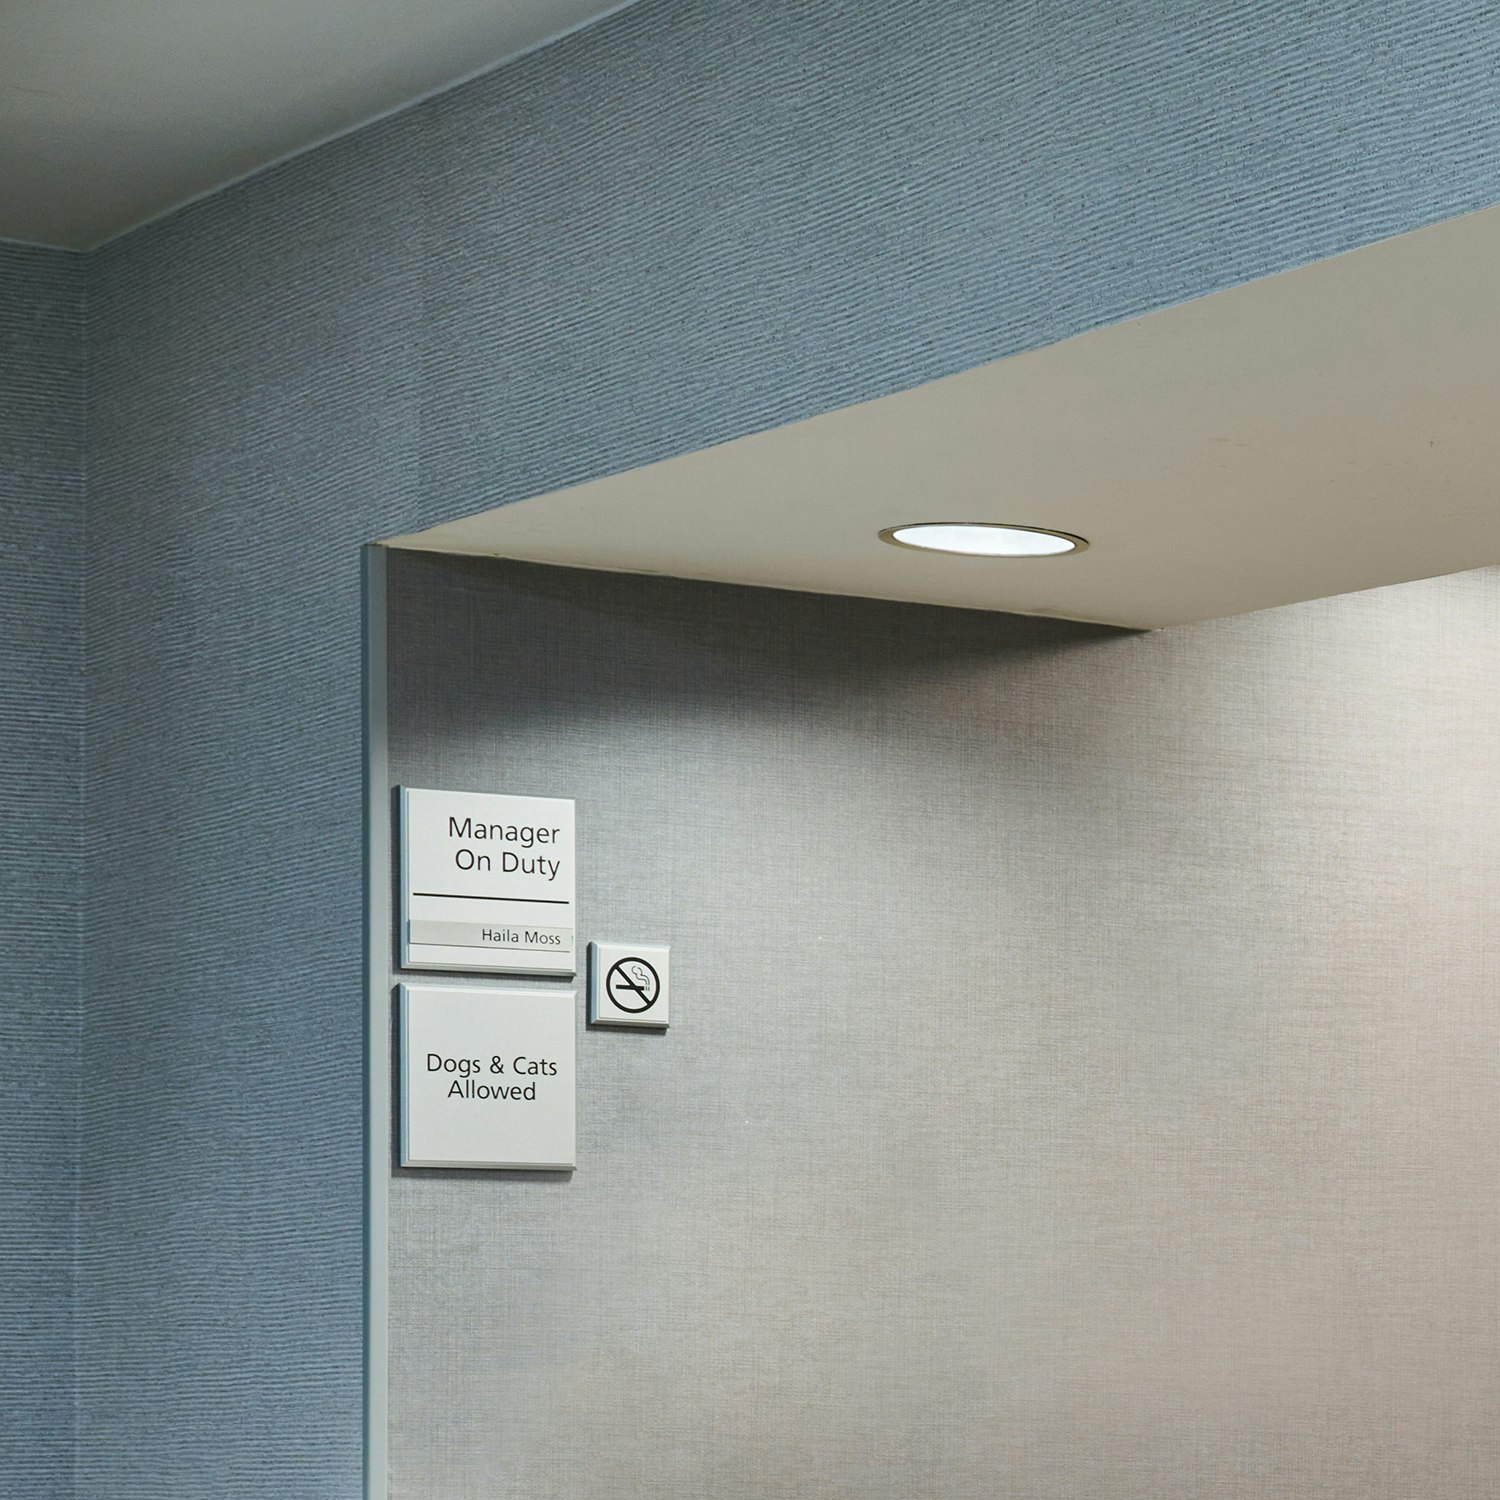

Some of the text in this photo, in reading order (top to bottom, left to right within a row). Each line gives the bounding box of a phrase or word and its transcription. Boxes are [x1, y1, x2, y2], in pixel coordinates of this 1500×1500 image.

[449, 816, 560, 848] Manager
[455, 848, 560, 881] On Duty
[482, 928, 561, 945] Haila Moss
[427, 1053, 557, 1078] Dogs & Cats
[447, 1081, 536, 1101] Allowed
